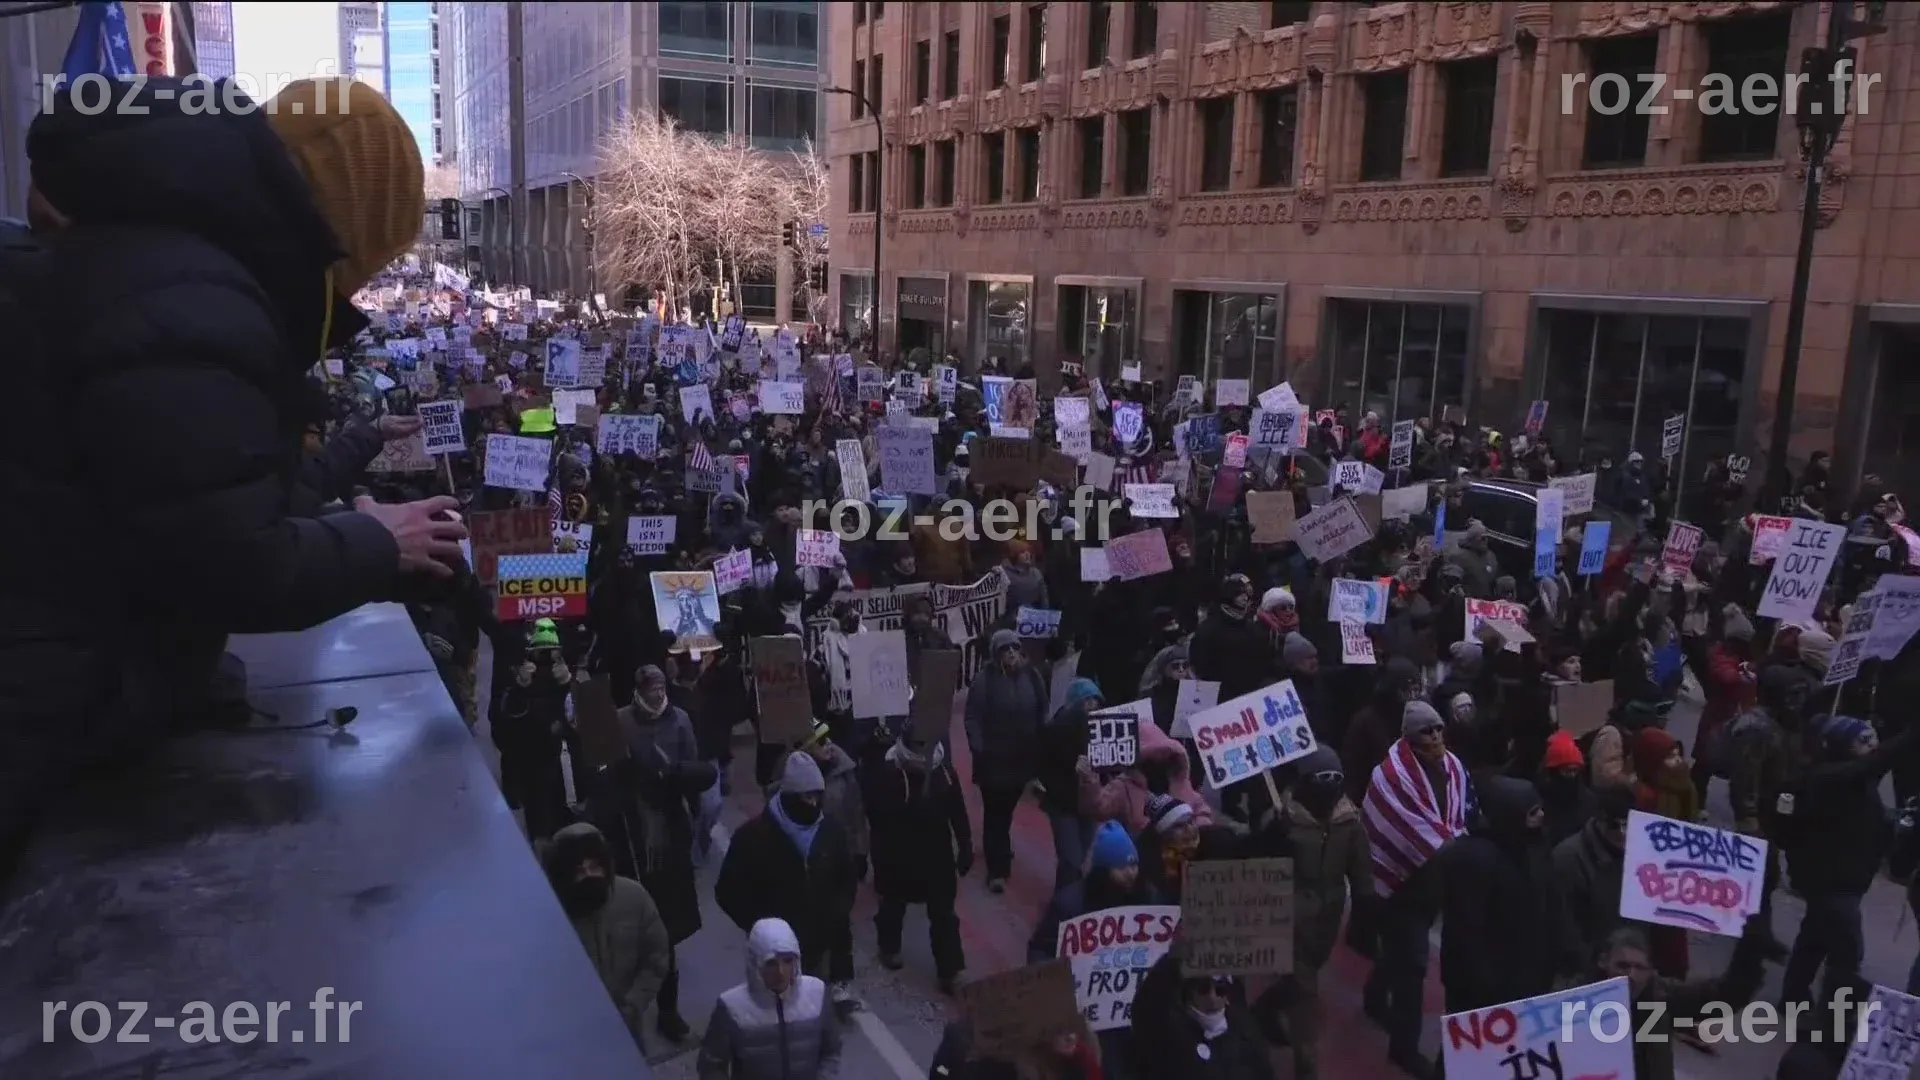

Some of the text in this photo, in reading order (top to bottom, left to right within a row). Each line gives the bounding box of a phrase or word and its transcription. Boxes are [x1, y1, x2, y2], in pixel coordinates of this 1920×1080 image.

[901, 373, 914, 388] ICE
[426, 435, 461, 447] JUSTICE
[1257, 429, 1289, 445] ICE
[641, 519, 664, 531] THIS
[1792, 526, 1831, 550] ICE
[1582, 549, 1603, 569] OUT
[1783, 553, 1824, 576] OUT
[499, 578, 581, 596] ICE OUT
[517, 596, 566, 615] MSP
[1263, 690, 1304, 727] dick
[1060, 913, 1180, 956] ABOLIS
[1093, 946, 1149, 970] ICE
[1447, 1008, 1517, 1051] NO
